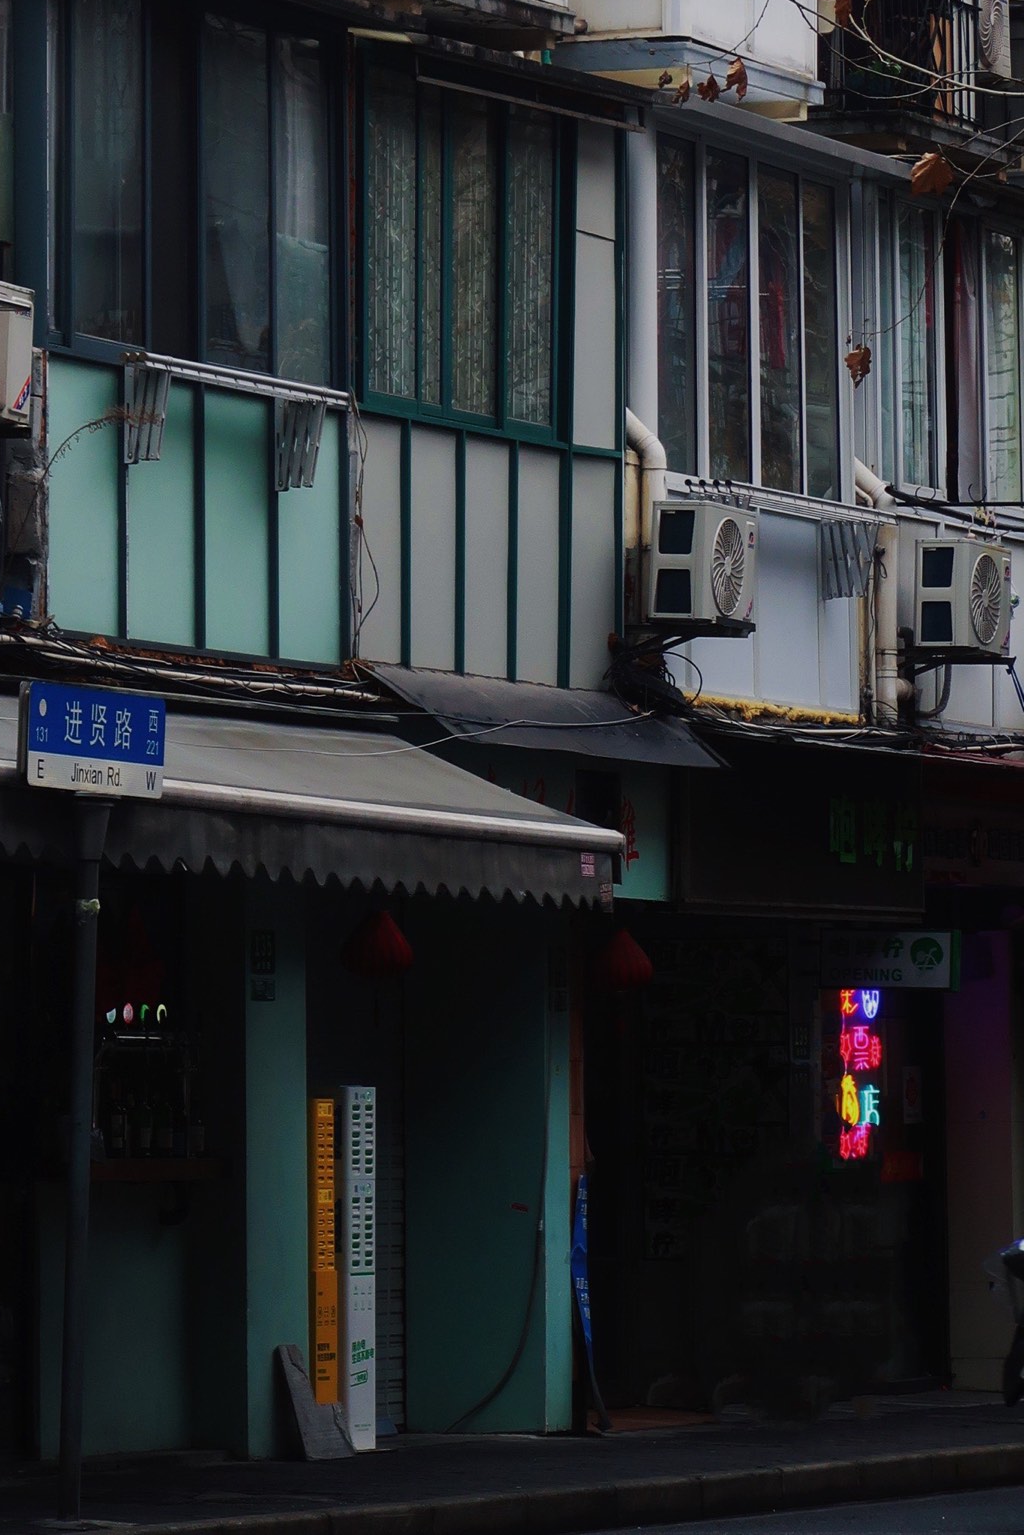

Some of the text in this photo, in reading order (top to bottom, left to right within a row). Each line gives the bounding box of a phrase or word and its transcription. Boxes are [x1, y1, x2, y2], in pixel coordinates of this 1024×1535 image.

[64, 700, 132, 750] 进贤路
[148, 709, 159, 733] 西
[36, 726, 48, 743] 131
[146, 739, 159, 755] 221
[37, 759, 44, 779] E
[71, 763, 122, 787] Jinxian Rd.
[146, 771, 156, 791] W
[830, 968, 903, 982] OPENING
